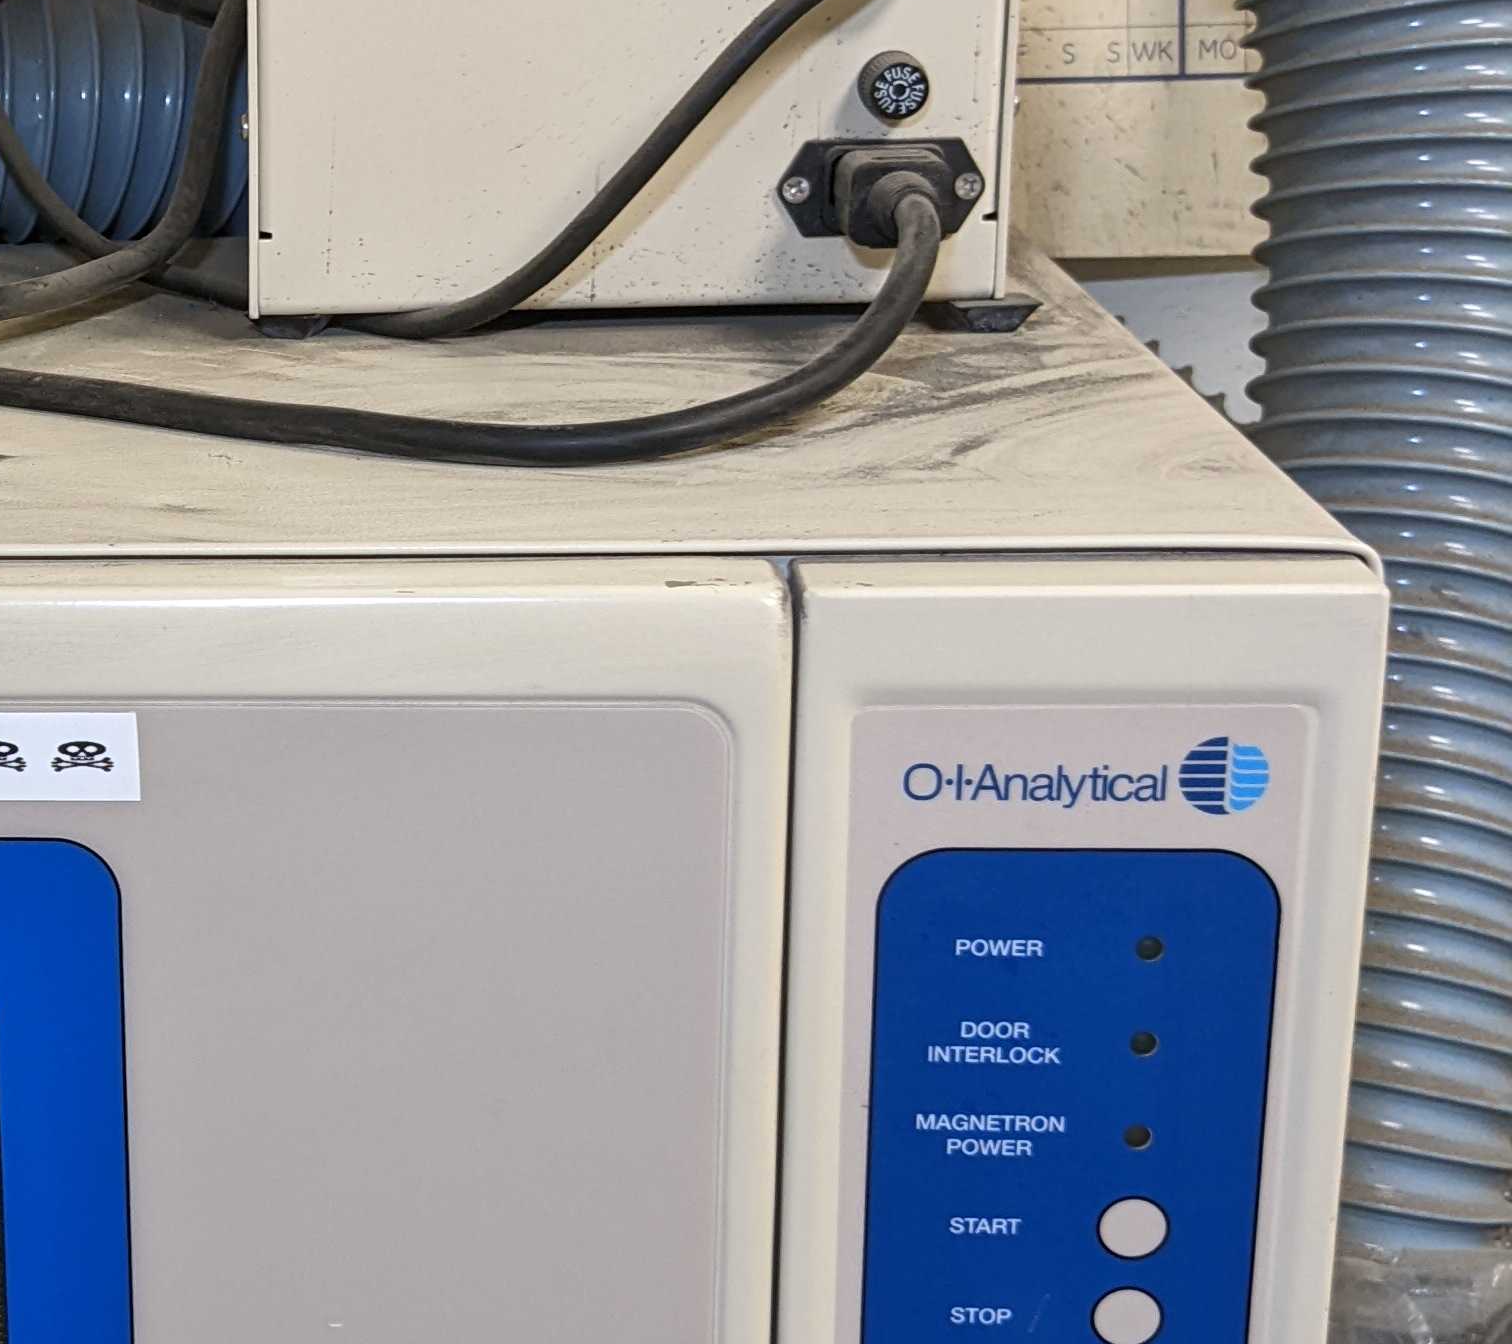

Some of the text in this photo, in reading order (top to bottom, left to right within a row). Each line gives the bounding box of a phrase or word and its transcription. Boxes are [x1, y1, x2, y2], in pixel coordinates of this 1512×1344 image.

[1062, 40, 1173, 65] S S WK
[1198, 39, 1237, 61] MO
[884, 66, 921, 84] FUSE
[874, 81, 896, 114] FUSE
[898, 84, 925, 114] FUSE
[955, 938, 1044, 958] POWER
[960, 1021, 1030, 1040] DOOR
[927, 1045, 1061, 1065] INTERLOCK
[915, 1113, 1066, 1133] MAGNETRON
[946, 1138, 1033, 1157] POWER
[949, 1216, 1022, 1236] START
[950, 1307, 1013, 1326] STOP
